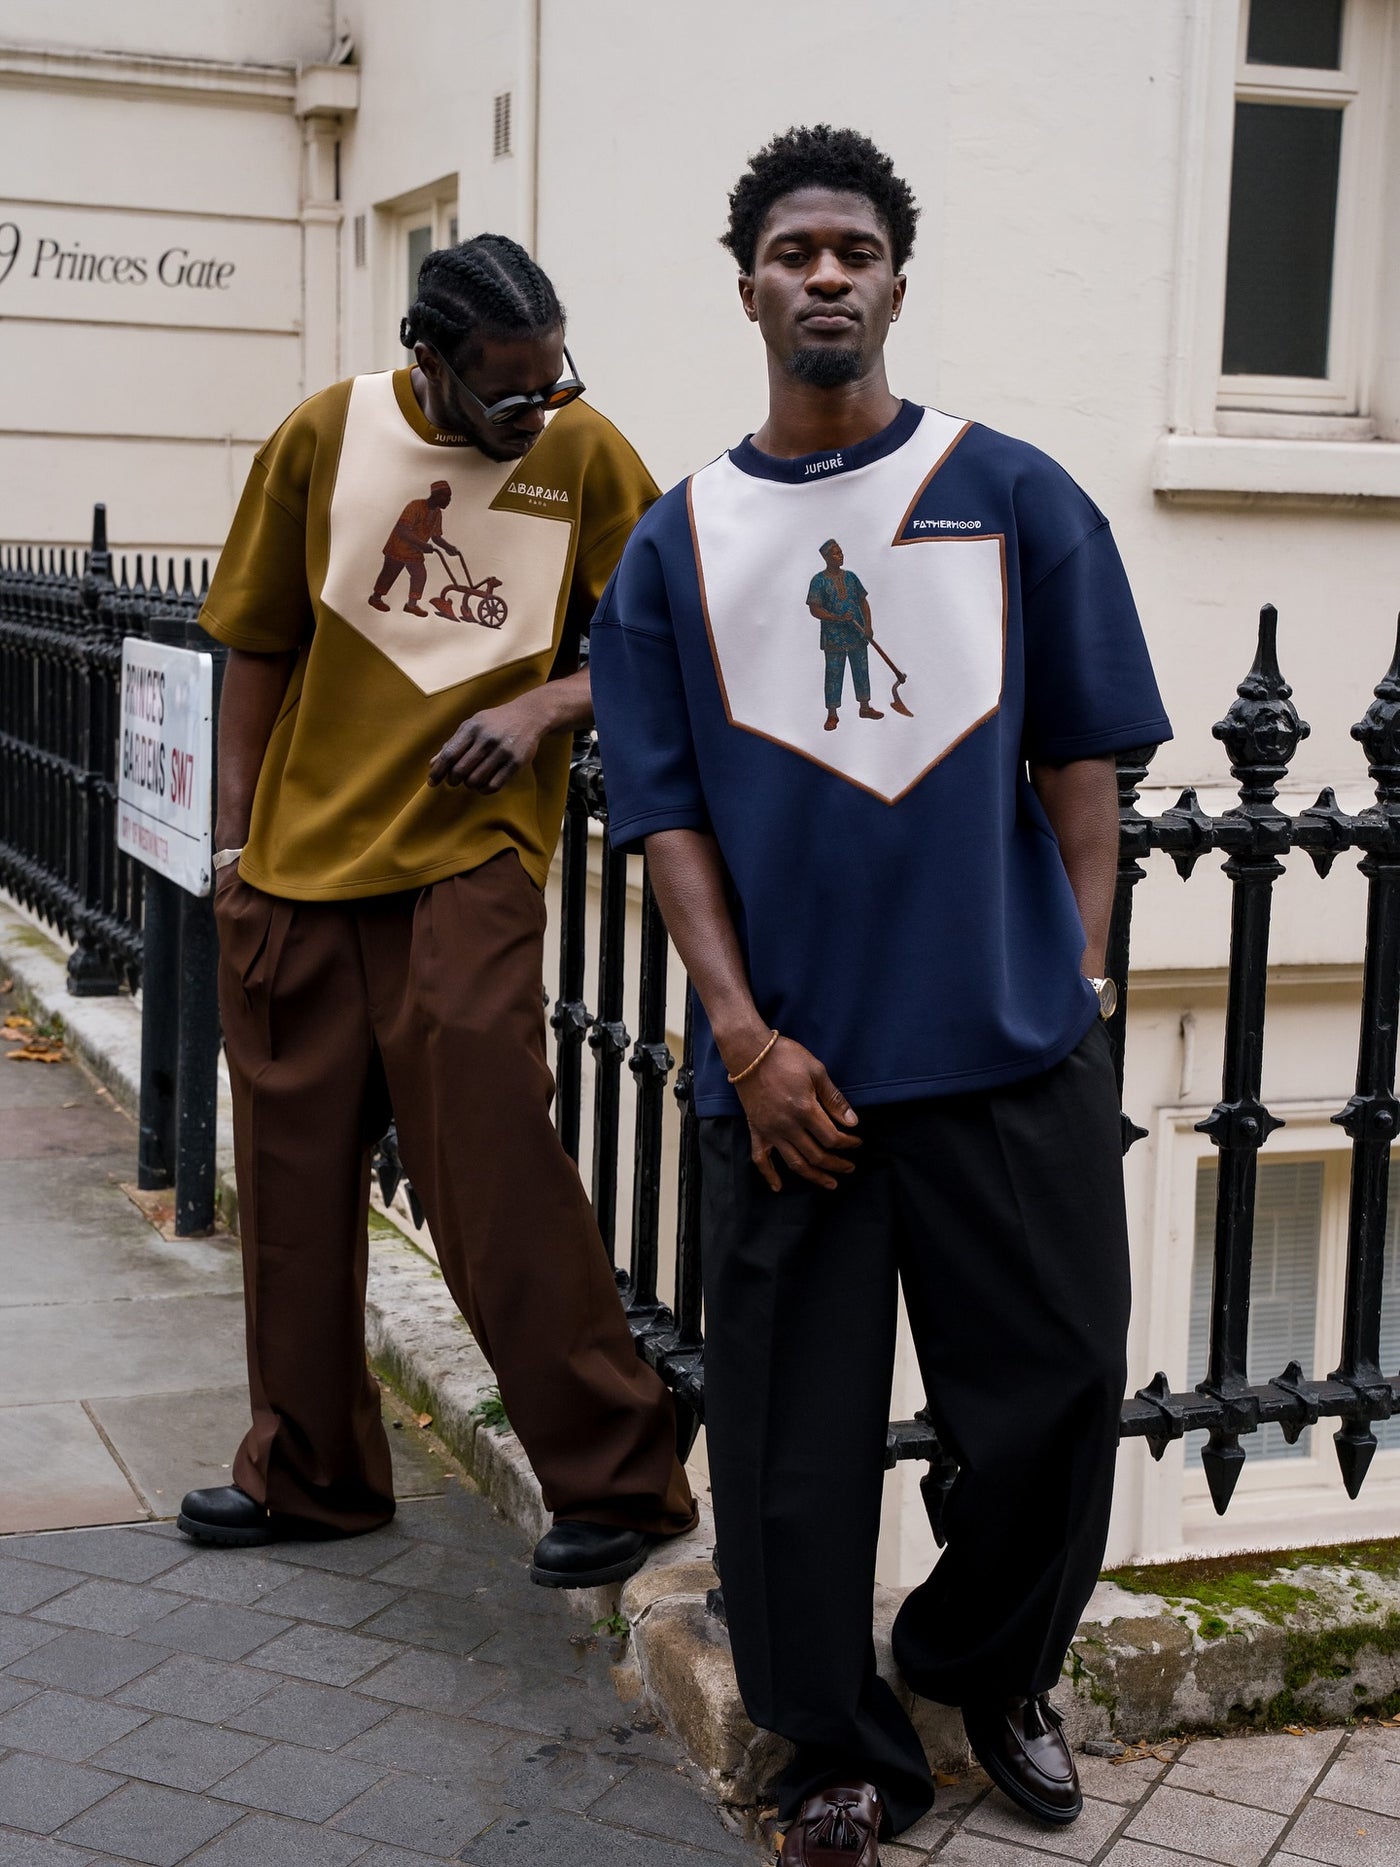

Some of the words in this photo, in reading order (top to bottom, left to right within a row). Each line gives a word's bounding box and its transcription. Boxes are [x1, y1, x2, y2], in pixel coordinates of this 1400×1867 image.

[30, 238, 148, 285] Princes
[157, 247, 236, 290] Gate
[507, 482, 569, 503] ABARAKA
[913, 520, 982, 530] FATHERHOOD
[123, 728, 166, 797] GARDENS
[170, 747, 194, 810] SW7
